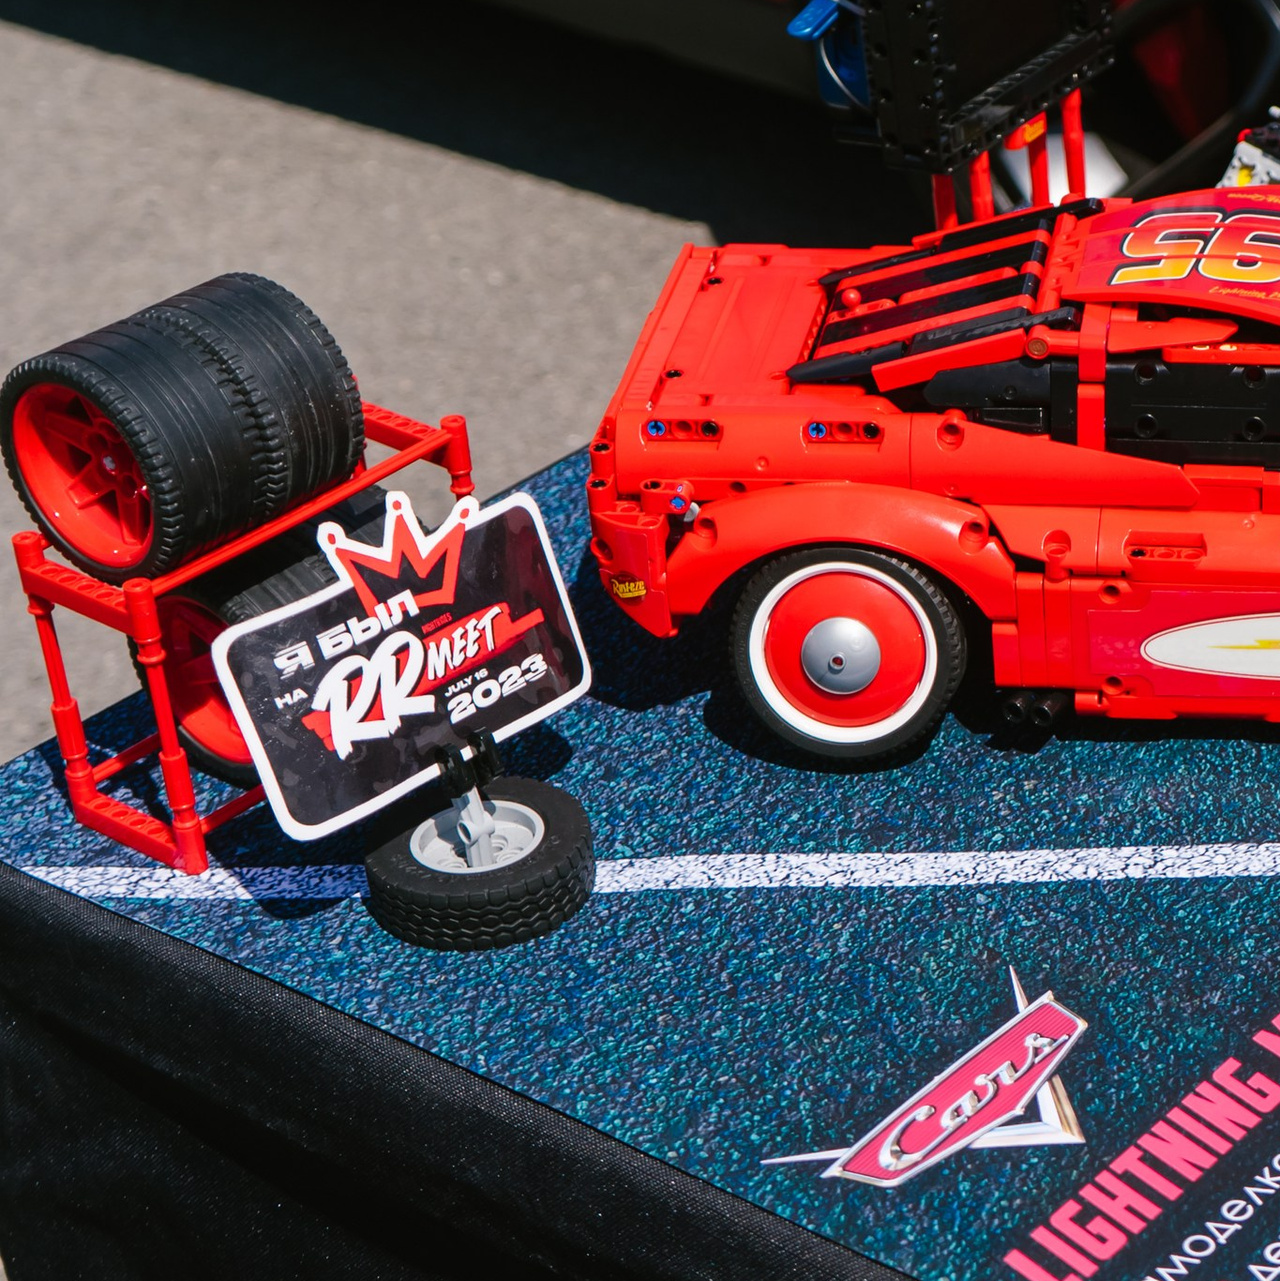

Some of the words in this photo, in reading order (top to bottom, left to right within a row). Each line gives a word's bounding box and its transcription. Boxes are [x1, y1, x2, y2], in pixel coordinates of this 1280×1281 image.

[273, 640, 315, 680] Я
[316, 588, 420, 661] БЫЛ
[273, 687, 309, 710] НА
[311, 631, 436, 761] RR
[426, 606, 502, 681] MEET
[444, 675, 473, 698] JULY
[472, 667, 489, 682] 16
[446, 652, 549, 725] 2023
[878, 1032, 1070, 1171] Cars
